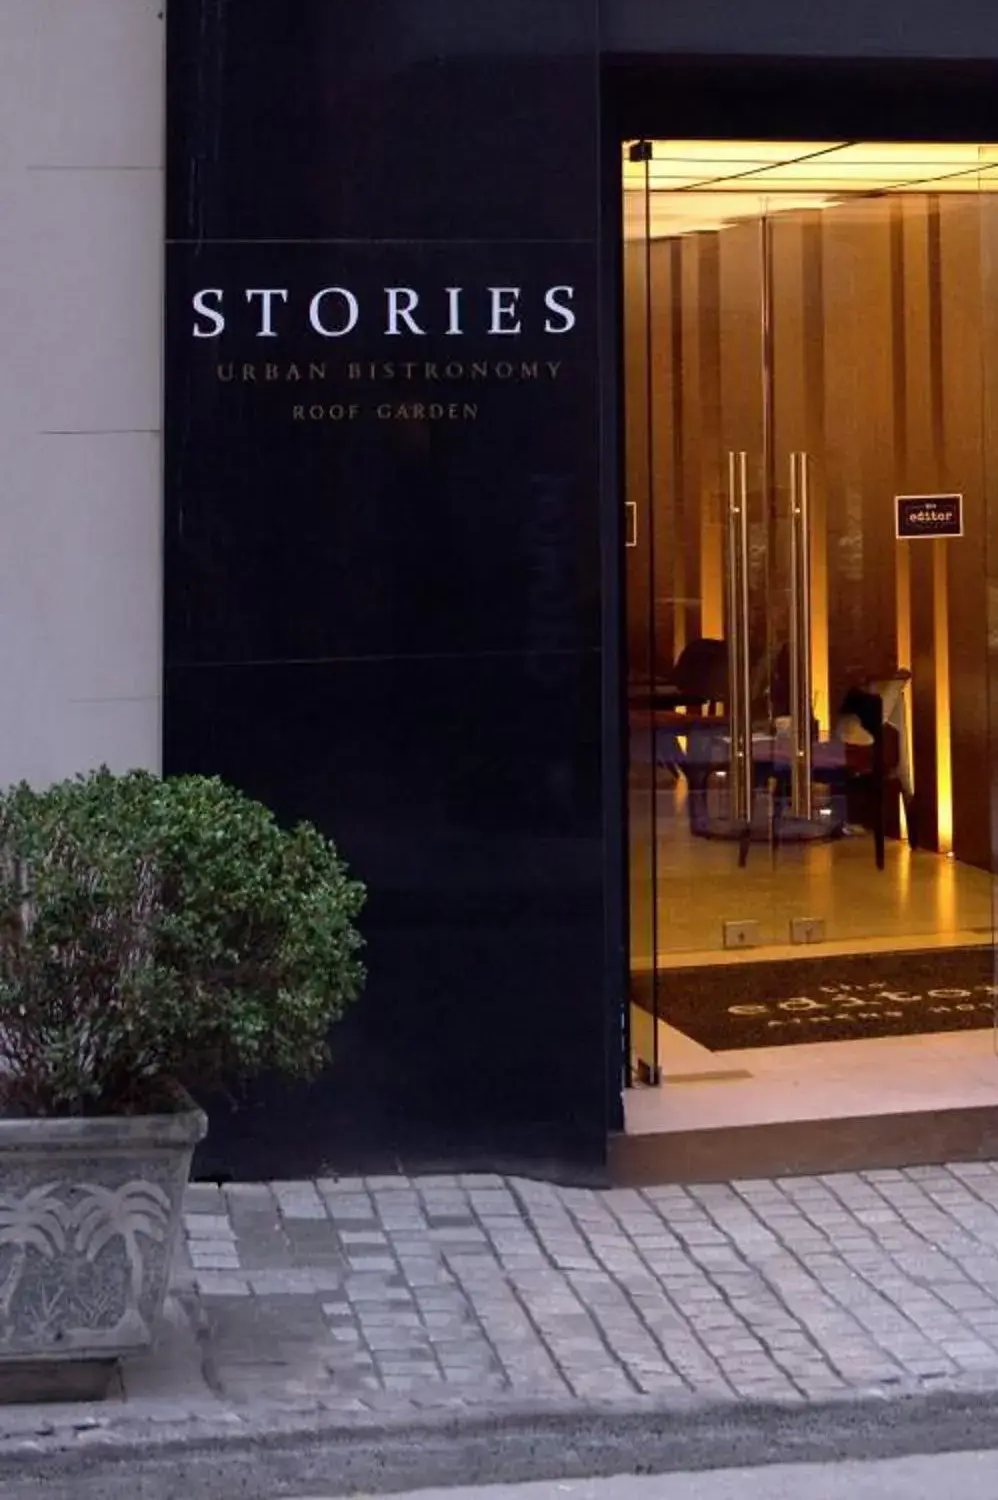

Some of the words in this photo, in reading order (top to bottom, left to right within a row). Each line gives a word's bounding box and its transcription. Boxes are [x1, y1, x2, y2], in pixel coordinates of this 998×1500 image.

[193, 286, 576, 338] STORIES
[217, 362, 326, 382] URBAN
[348, 361, 562, 381] BISTRONOMY
[293, 404, 359, 420] ROOF
[377, 403, 479, 420] GARDEN
[909, 510, 952, 522] editor
